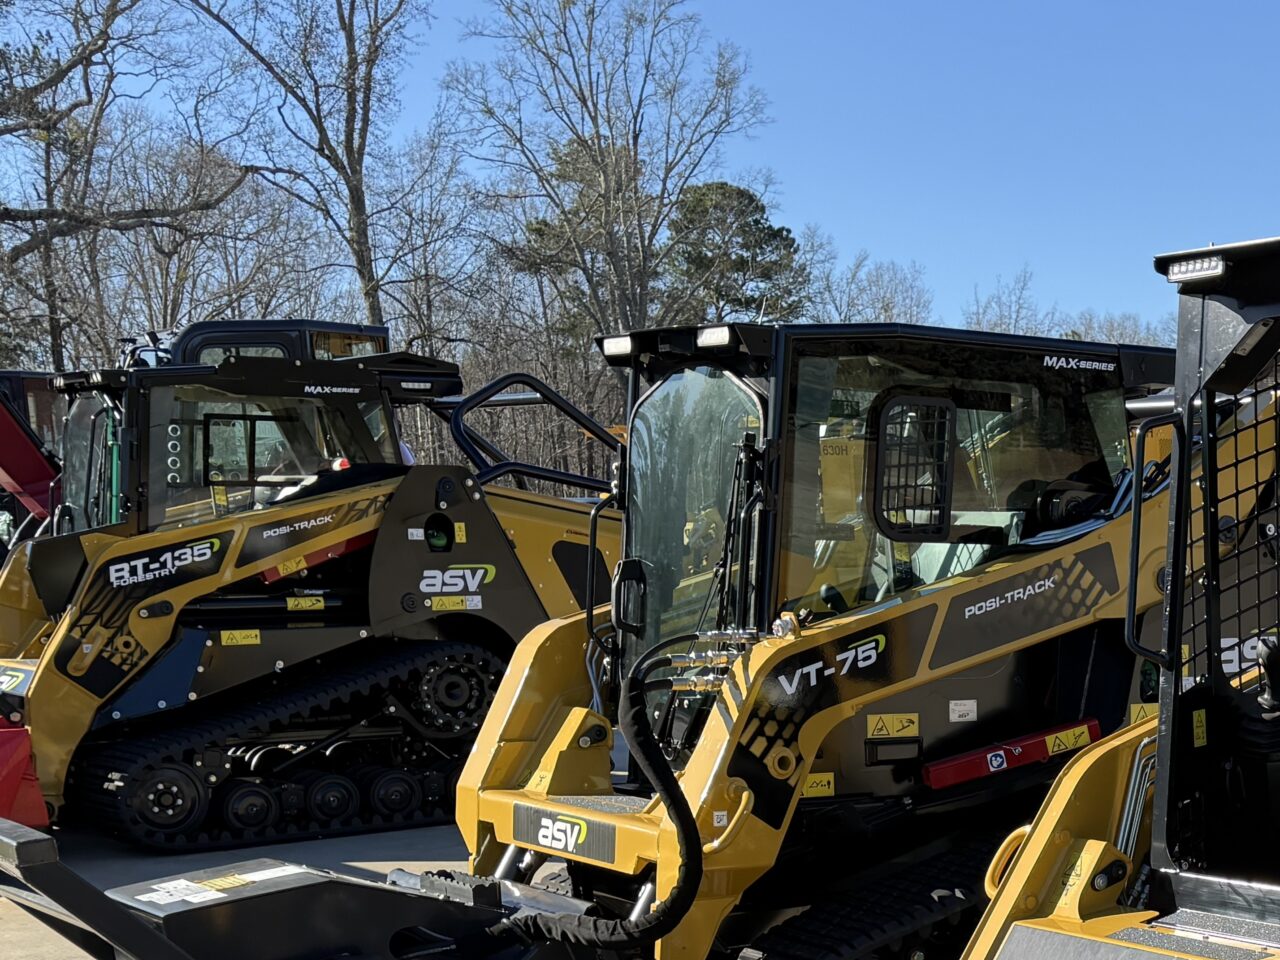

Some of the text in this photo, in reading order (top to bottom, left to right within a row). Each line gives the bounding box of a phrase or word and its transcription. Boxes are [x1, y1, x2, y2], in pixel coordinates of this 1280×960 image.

[1043, 355, 1116, 371] MAX-SERIES
[822, 444, 848, 456] 630H
[263, 514, 336, 539] POSI-TRACK
[109, 542, 212, 583] RT-135
[113, 566, 178, 588] FORESTRY
[964, 576, 1057, 619] POSI-TRACK
[778, 642, 878, 696] VT-75
